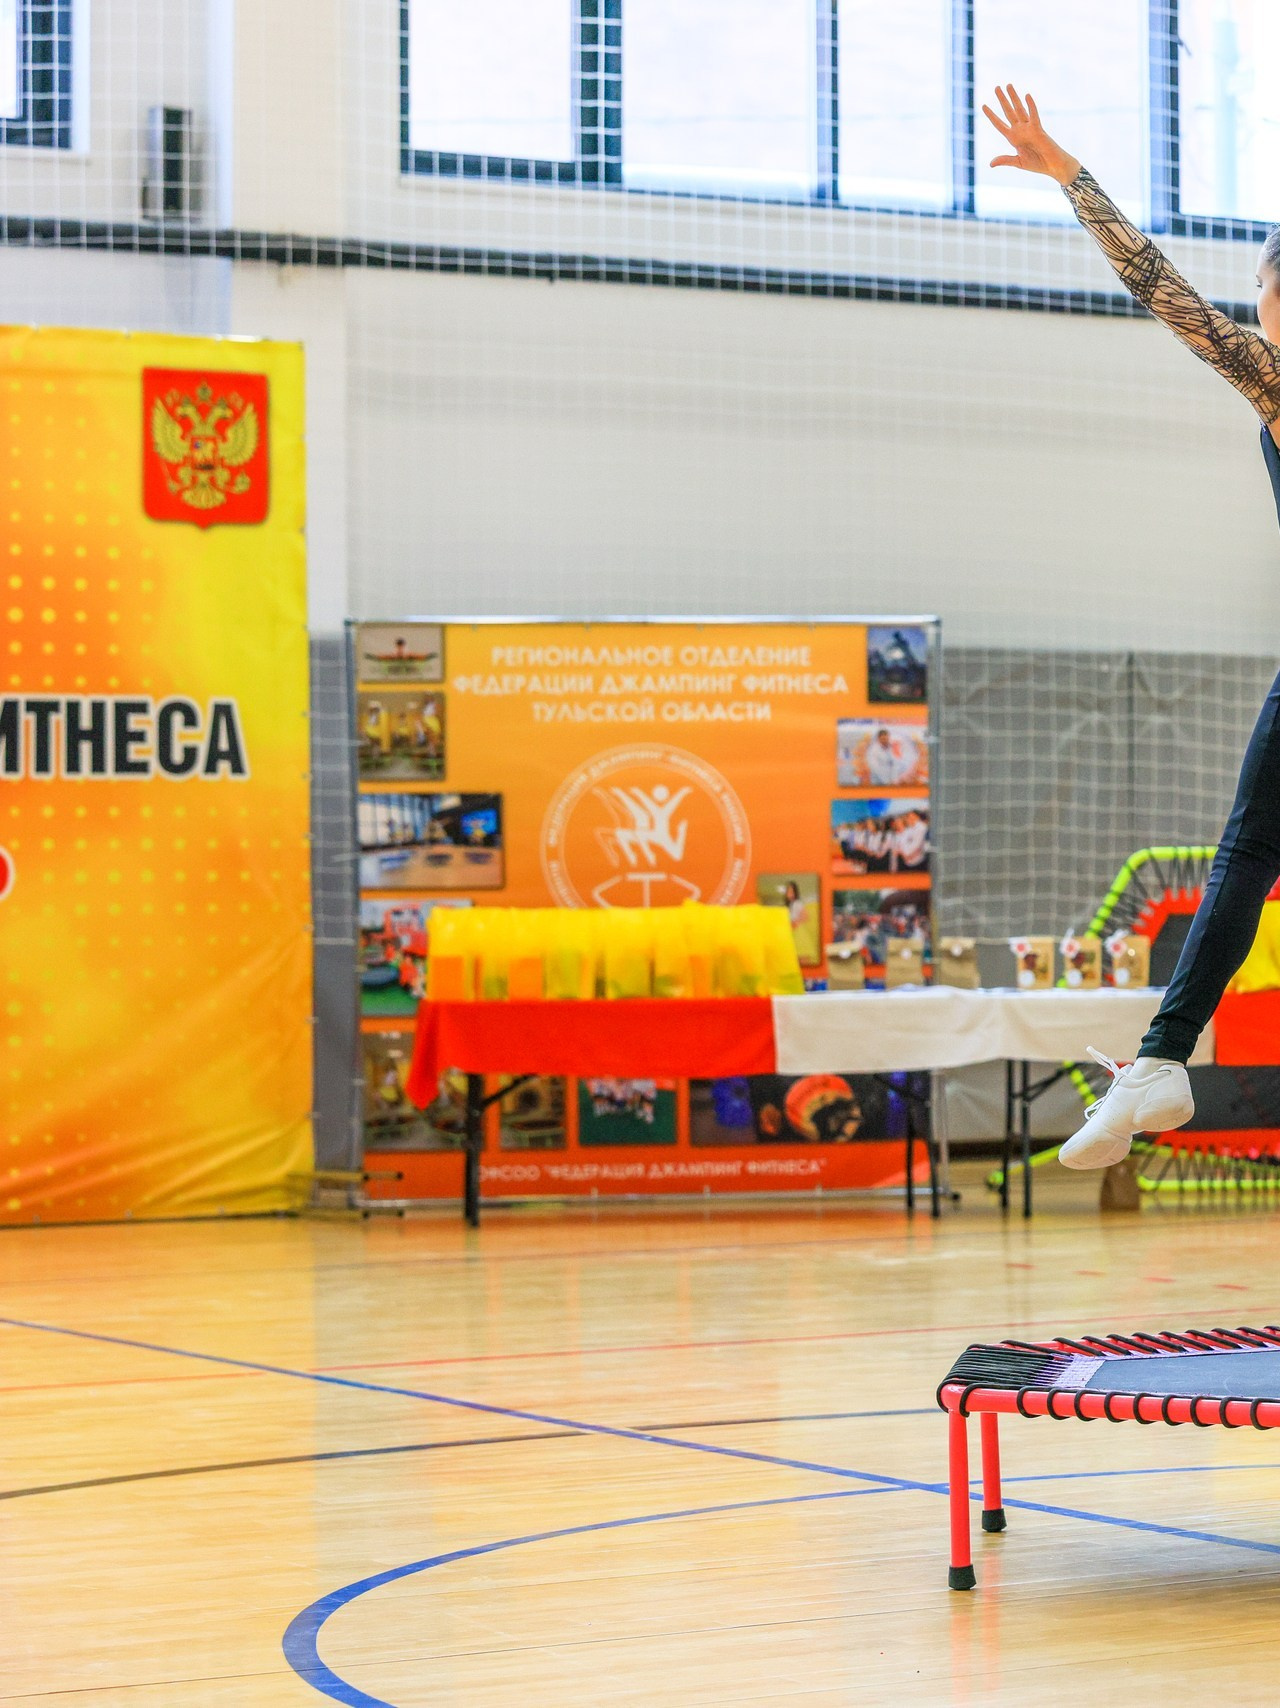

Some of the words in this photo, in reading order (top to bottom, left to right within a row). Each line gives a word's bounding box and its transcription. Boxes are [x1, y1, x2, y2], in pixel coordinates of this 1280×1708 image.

[490, 645, 674, 668] РЕГИОНАЛЬНОЕ
[679, 645, 812, 668] ОТДЕЛЕНИЕ
[452, 673, 595, 696] ФЕДЕРАЦИИ
[598, 673, 738, 696] ДЖАМПИНГ
[741, 673, 850, 695] ФИТНЕСА
[532, 697, 657, 723] ТУЛЬСКОЙ
[660, 700, 773, 723] ОБЛАСТИ
